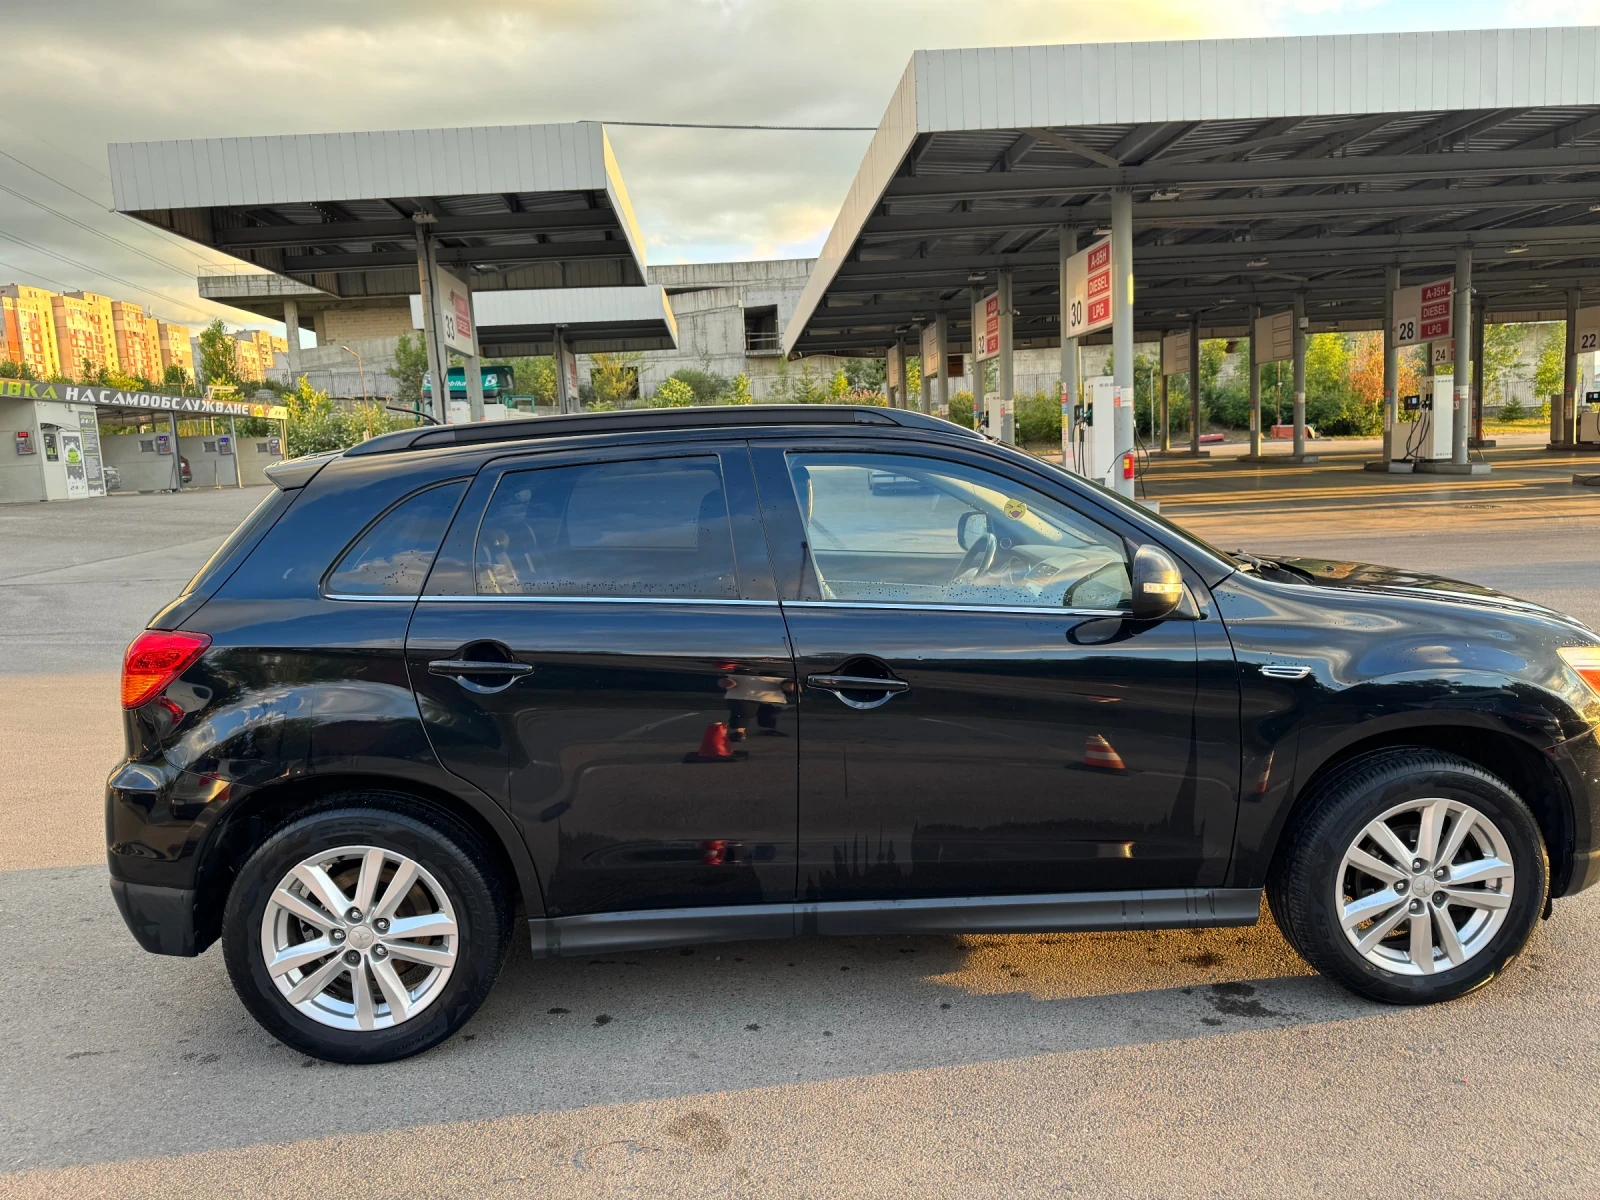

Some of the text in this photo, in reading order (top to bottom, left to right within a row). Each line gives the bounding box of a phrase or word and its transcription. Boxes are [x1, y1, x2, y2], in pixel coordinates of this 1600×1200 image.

[1088, 275, 1108, 295] DIESEL
[1071, 300, 1082, 327] 30
[1092, 303, 1105, 319] LPG
[1423, 304, 1448, 318] DIESEL
[445, 314, 455, 341] 33
[1399, 321, 1414, 341] 28
[1427, 323, 1442, 335] LPG
[1581, 333, 1597, 349] 22
[1435, 348, 1446, 362] 24
[65, 386, 96, 403] НА
[99, 390, 249, 415] САМООБСЛУЖВАНЕ
